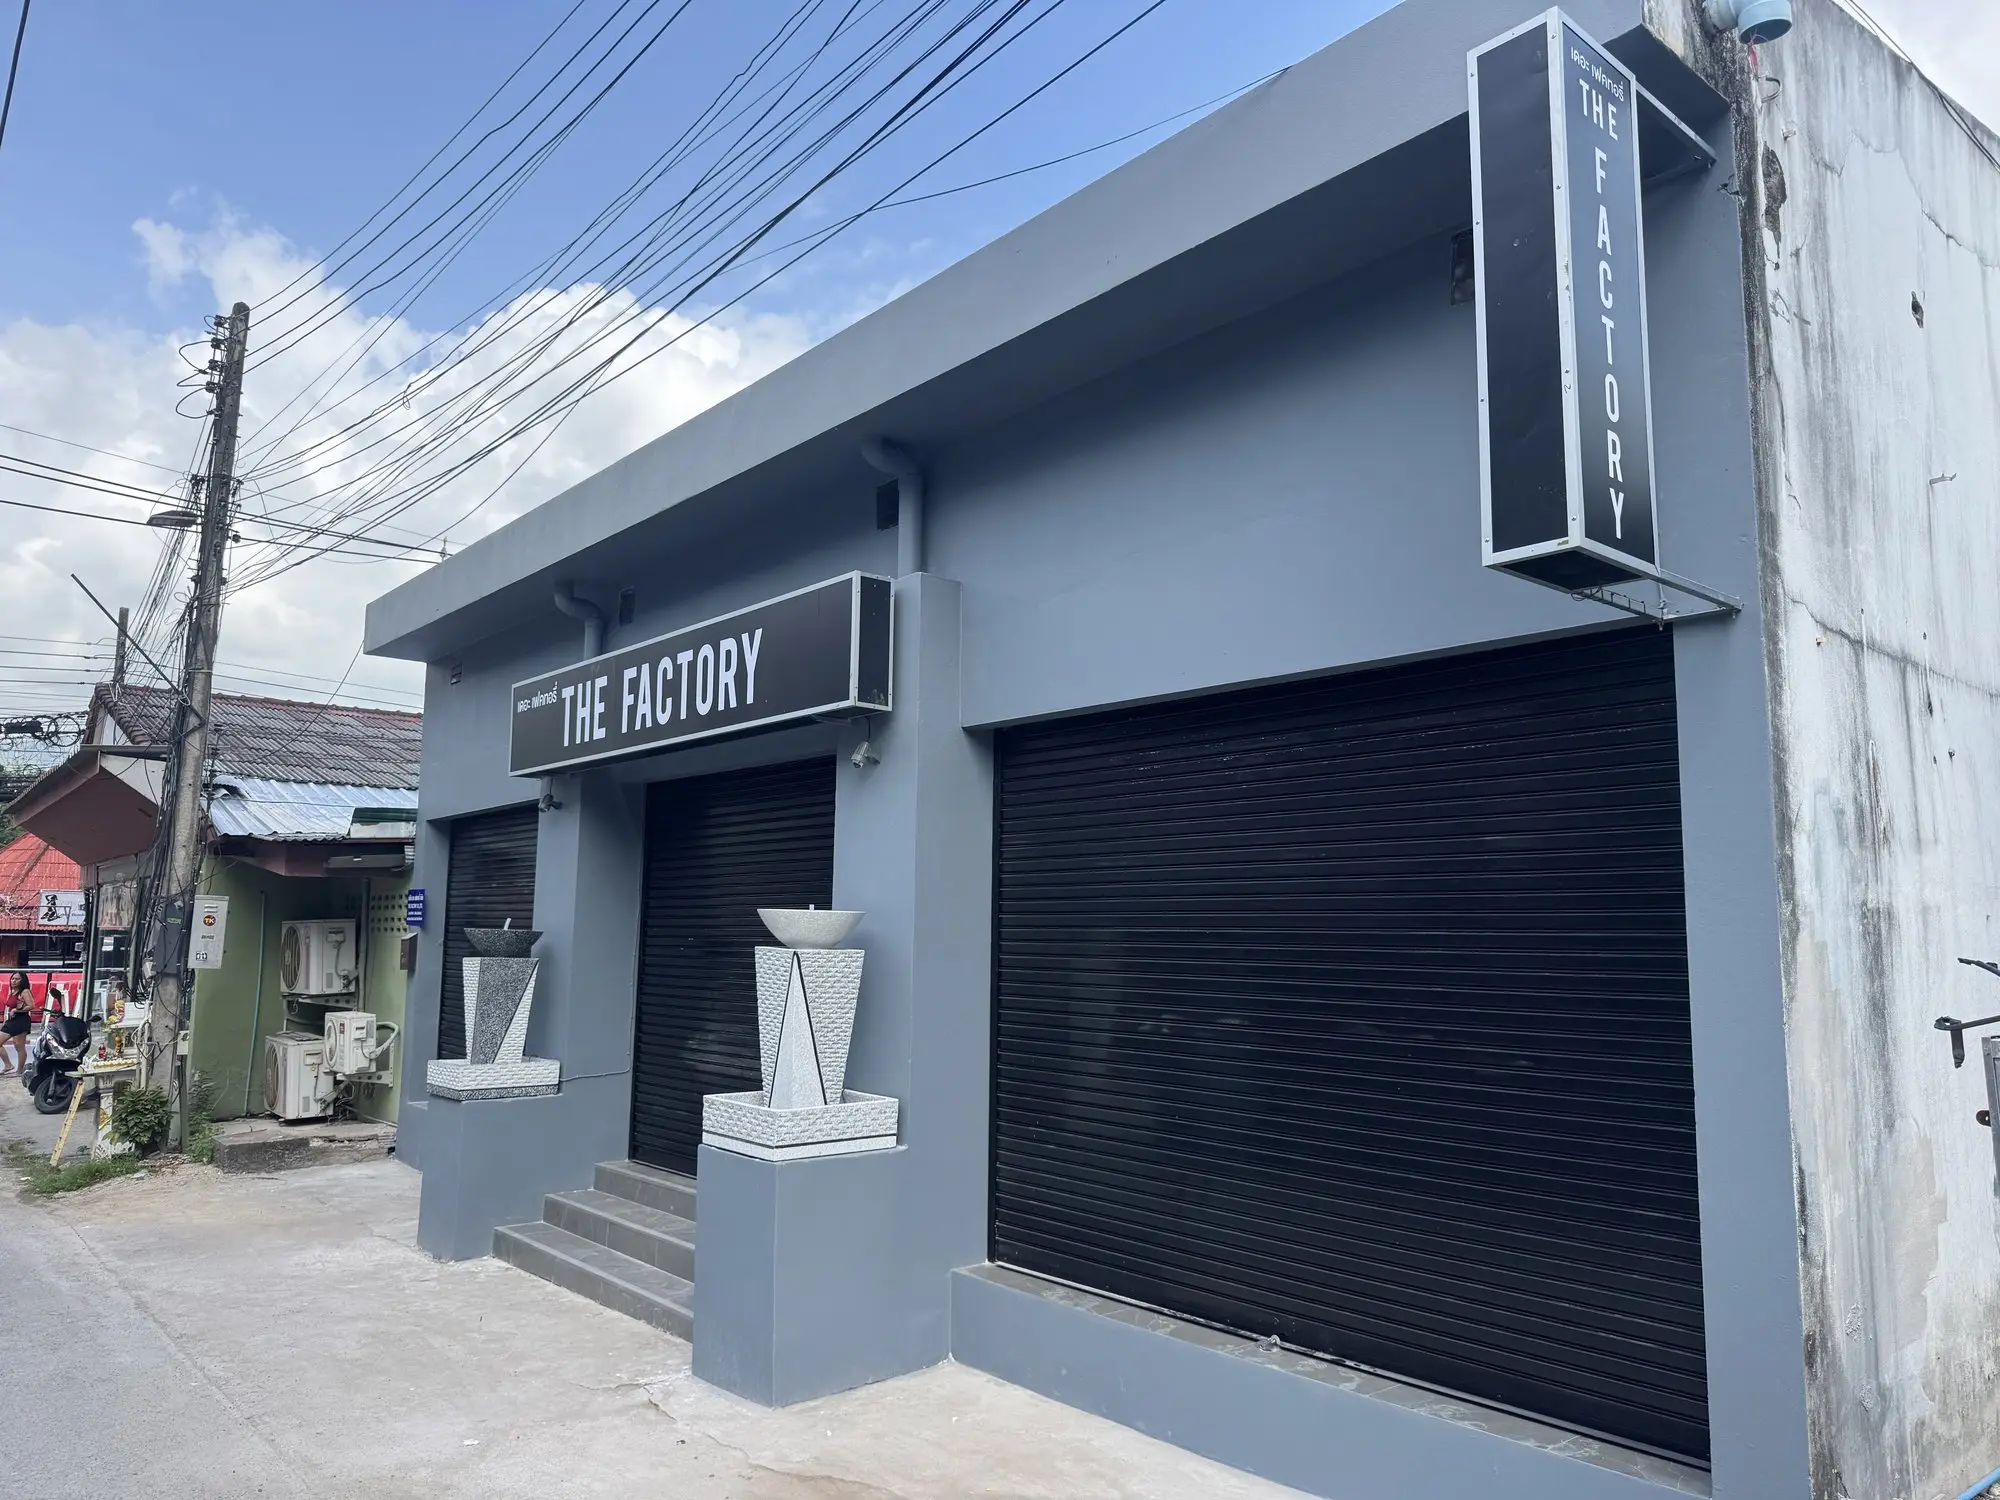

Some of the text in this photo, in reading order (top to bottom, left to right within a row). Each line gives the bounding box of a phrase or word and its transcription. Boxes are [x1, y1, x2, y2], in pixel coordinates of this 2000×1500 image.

[1579, 78, 1619, 141] THE
[1595, 146, 1625, 539] FACTORY
[561, 627, 763, 747] THE FACTORY
